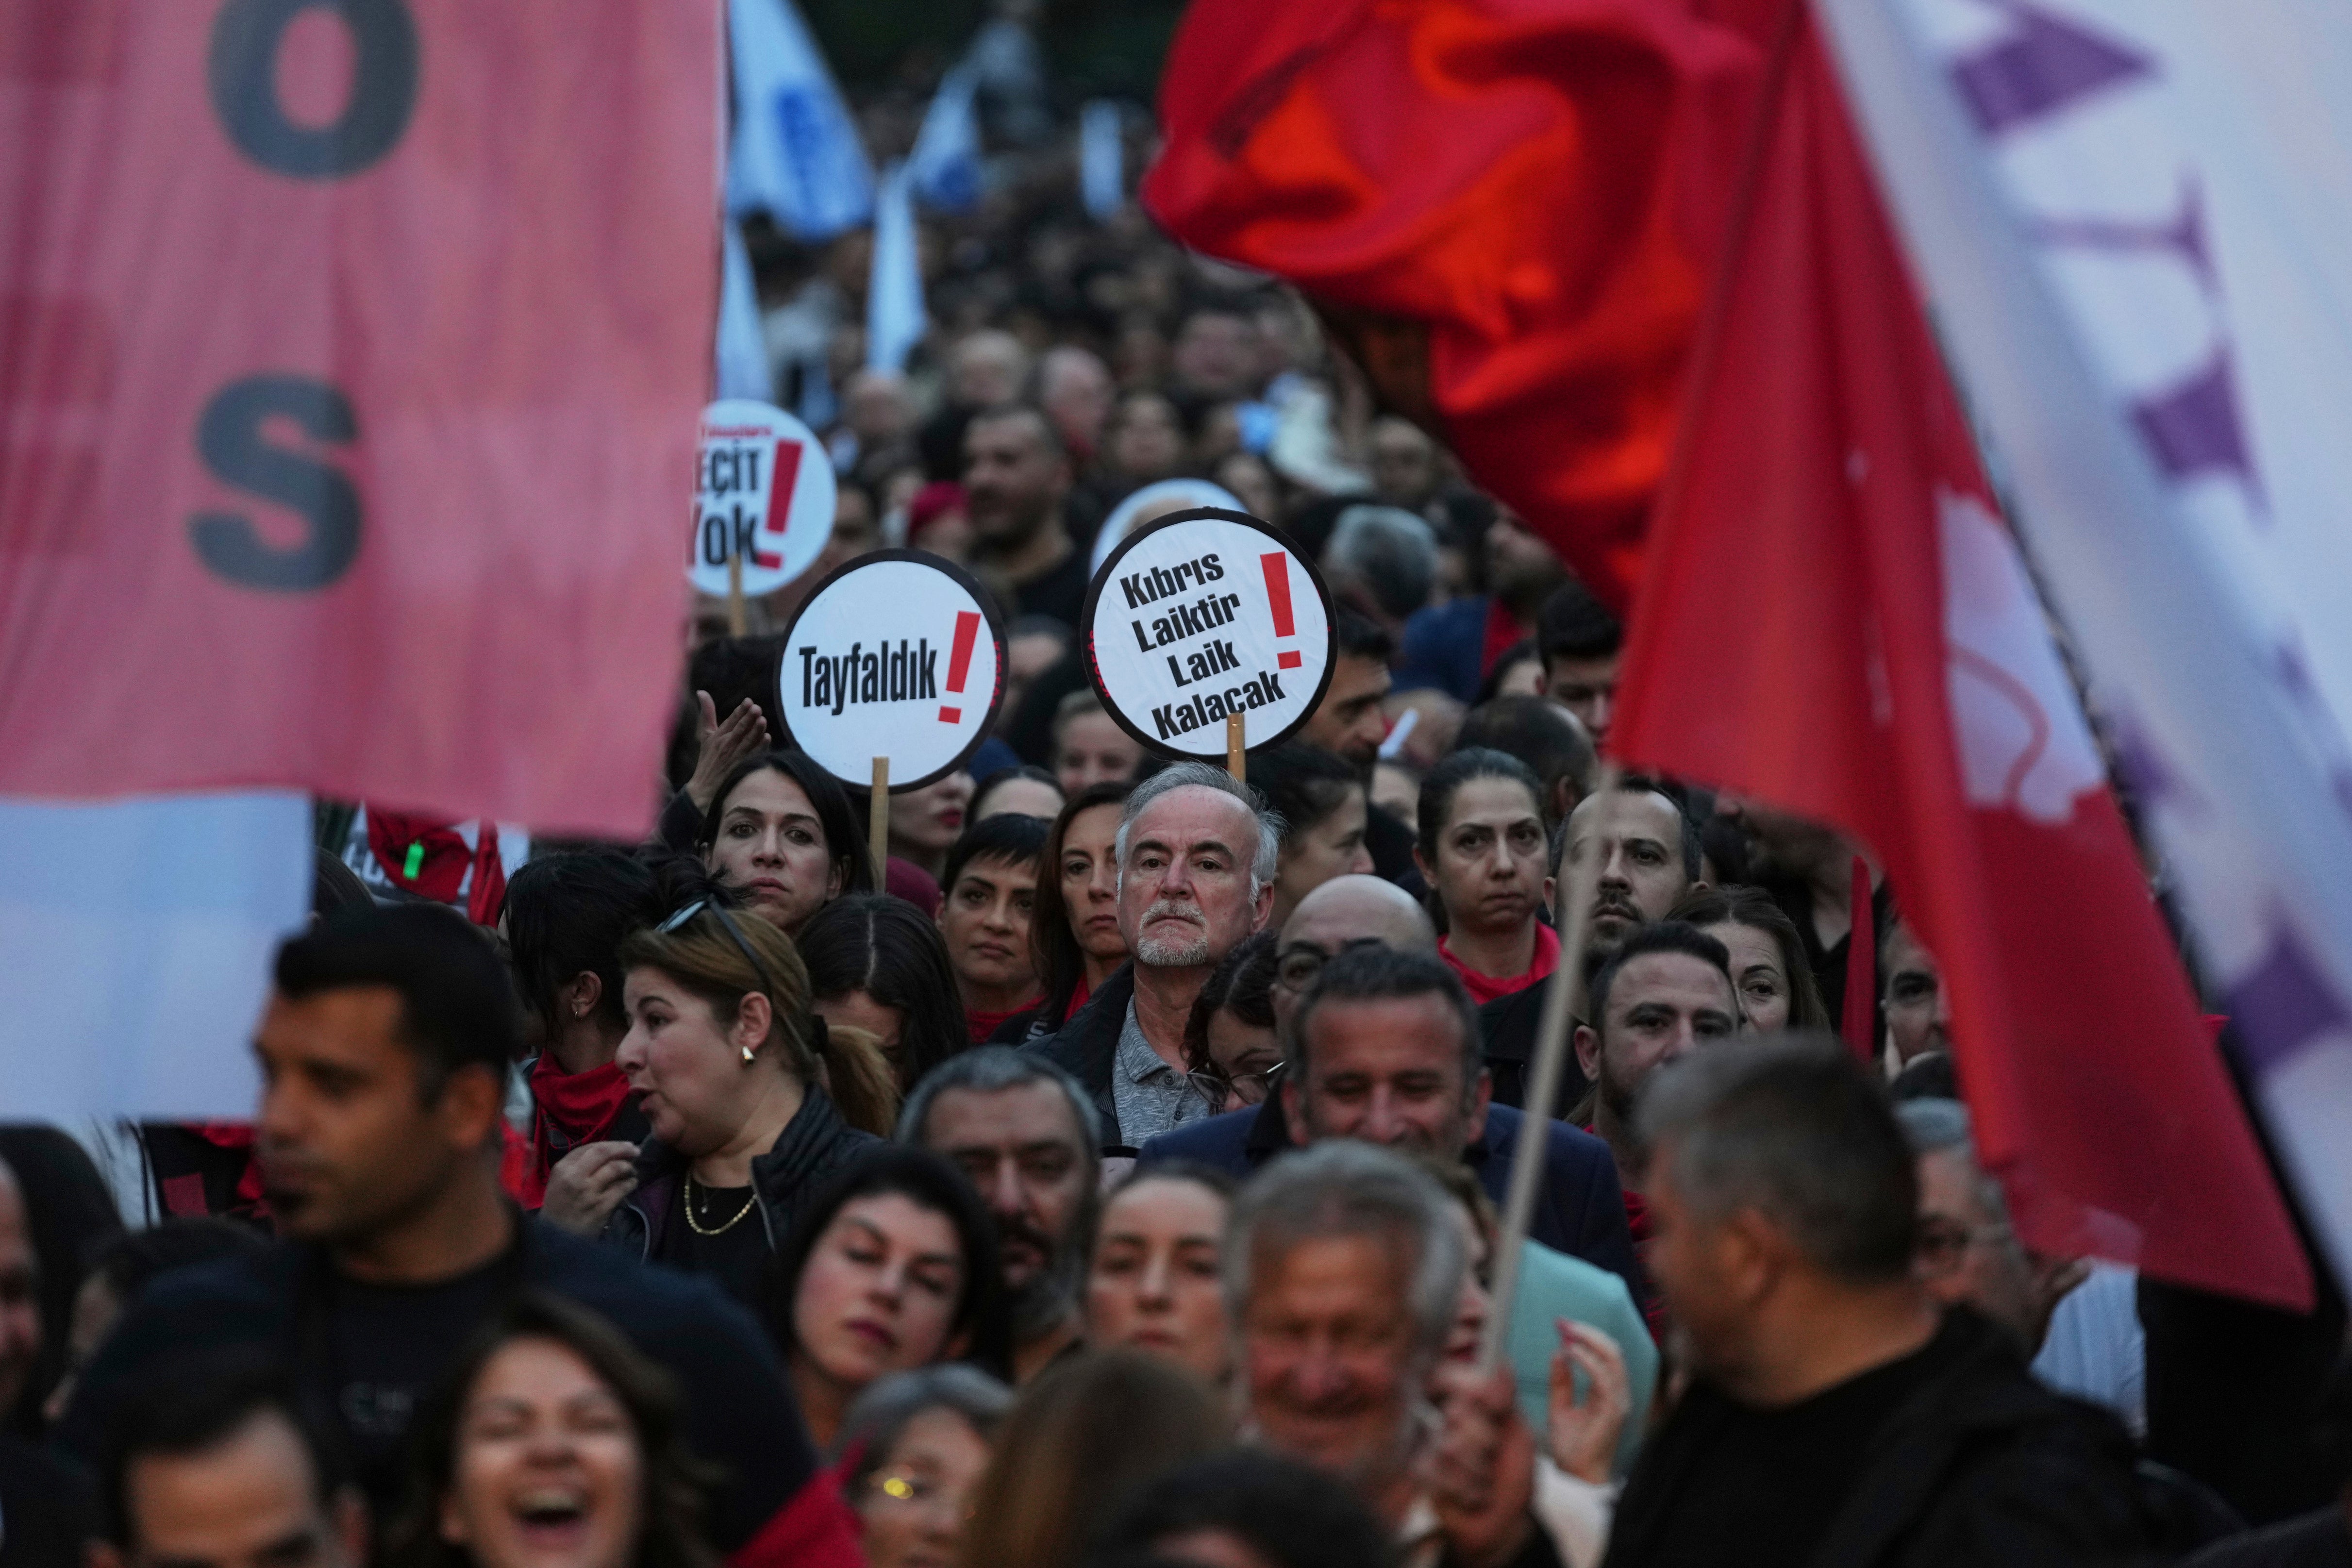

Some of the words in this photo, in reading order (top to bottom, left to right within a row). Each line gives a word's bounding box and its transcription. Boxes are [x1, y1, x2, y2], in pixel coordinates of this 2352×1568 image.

[695, 438, 761, 500] EÇİT
[1119, 552, 1224, 610] Kıbrıs
[1131, 592, 1241, 653] Laiktir
[799, 637, 938, 716] Tayfaldık
[1166, 638, 1241, 688] Laik
[1151, 669, 1287, 741] Kalacak
